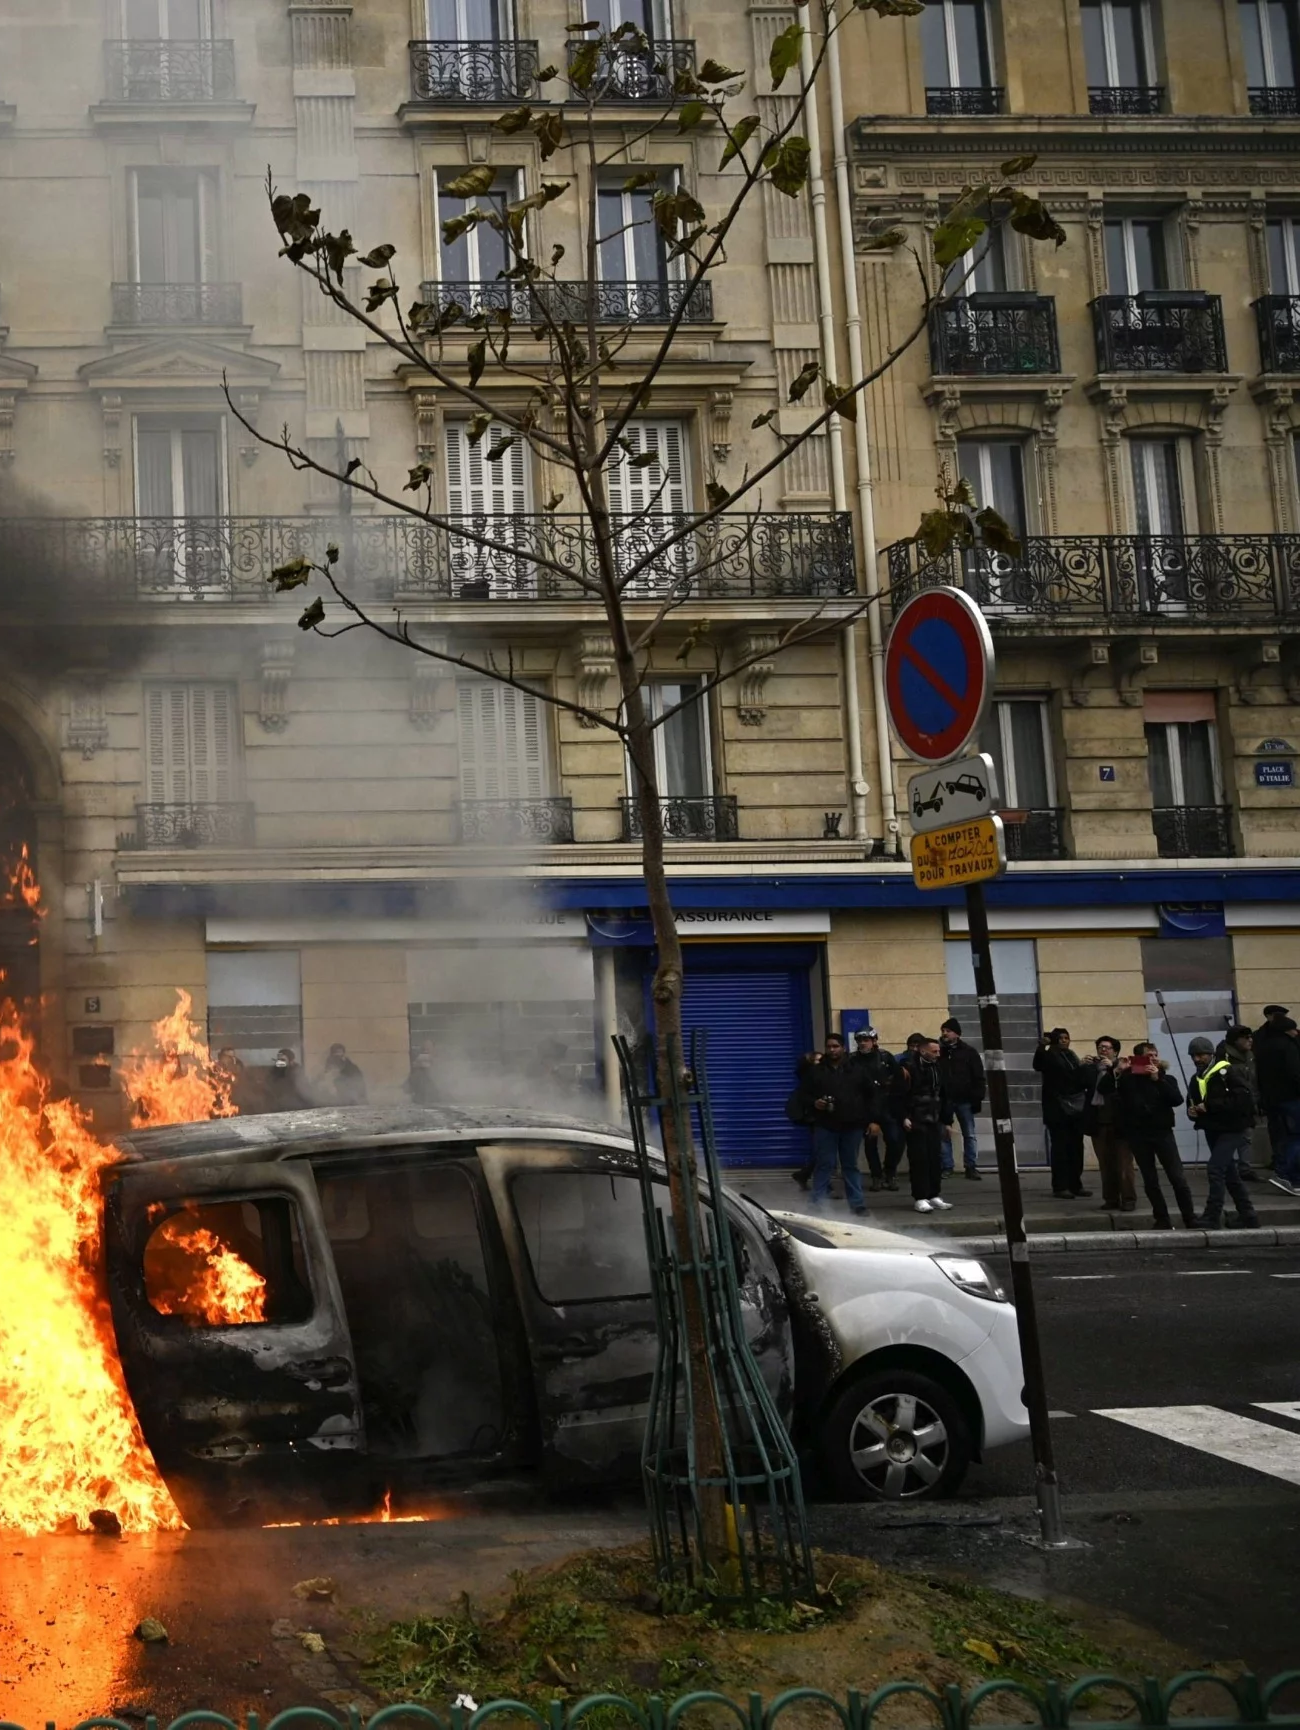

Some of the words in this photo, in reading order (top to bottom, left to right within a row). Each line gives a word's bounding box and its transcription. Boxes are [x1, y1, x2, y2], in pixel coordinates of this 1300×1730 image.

[1102, 767, 1111, 780] 7
[934, 826, 981, 847] COMPTER
[917, 855, 929, 868] DU
[920, 867, 945, 882] POUR
[949, 857, 994, 877] TRAVAUX
[674, 910, 774, 923] ASSURANCE
[87, 998, 98, 1012] 5
